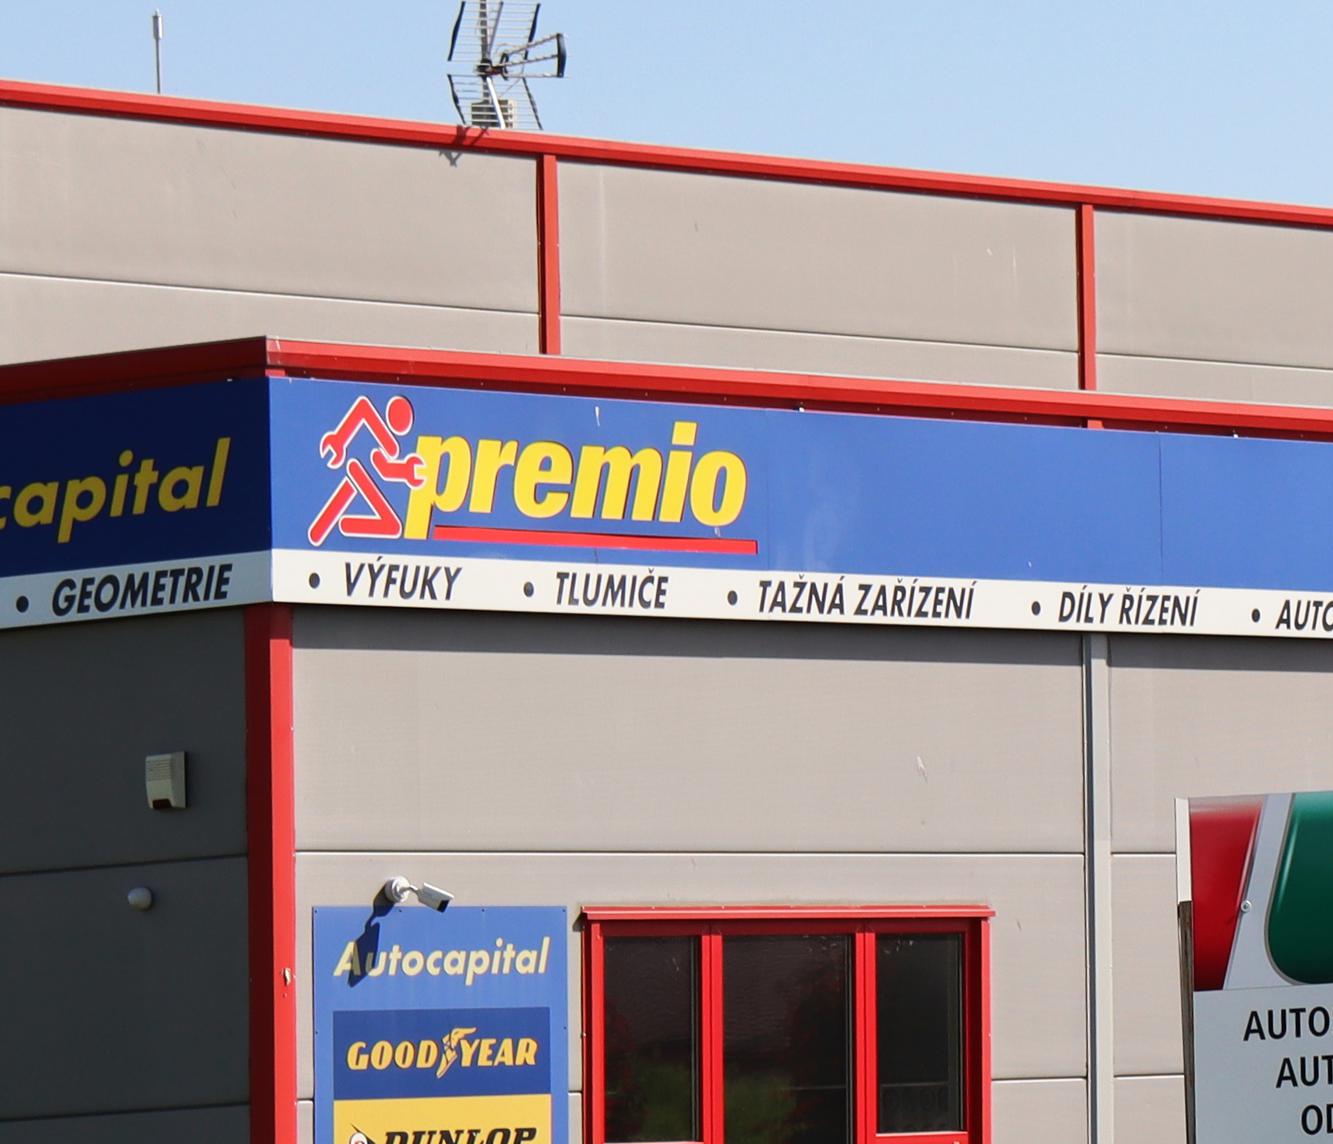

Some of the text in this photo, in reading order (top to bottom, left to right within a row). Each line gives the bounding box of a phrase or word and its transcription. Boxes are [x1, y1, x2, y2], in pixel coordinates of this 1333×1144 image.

[403, 422, 748, 539] premio
[52, 563, 233, 616] GEOMETRIE
[344, 556, 462, 600] VÝFUKY
[556, 567, 669, 609] TLUMIČE
[758, 574, 848, 616] TAŽNÁ
[853, 576, 977, 620] ZAŘÍZENÍ
[1059, 584, 1113, 625] DÍLY
[1119, 586, 1201, 627] ŘÍZENÍ
[333, 937, 551, 986] Autocapital
